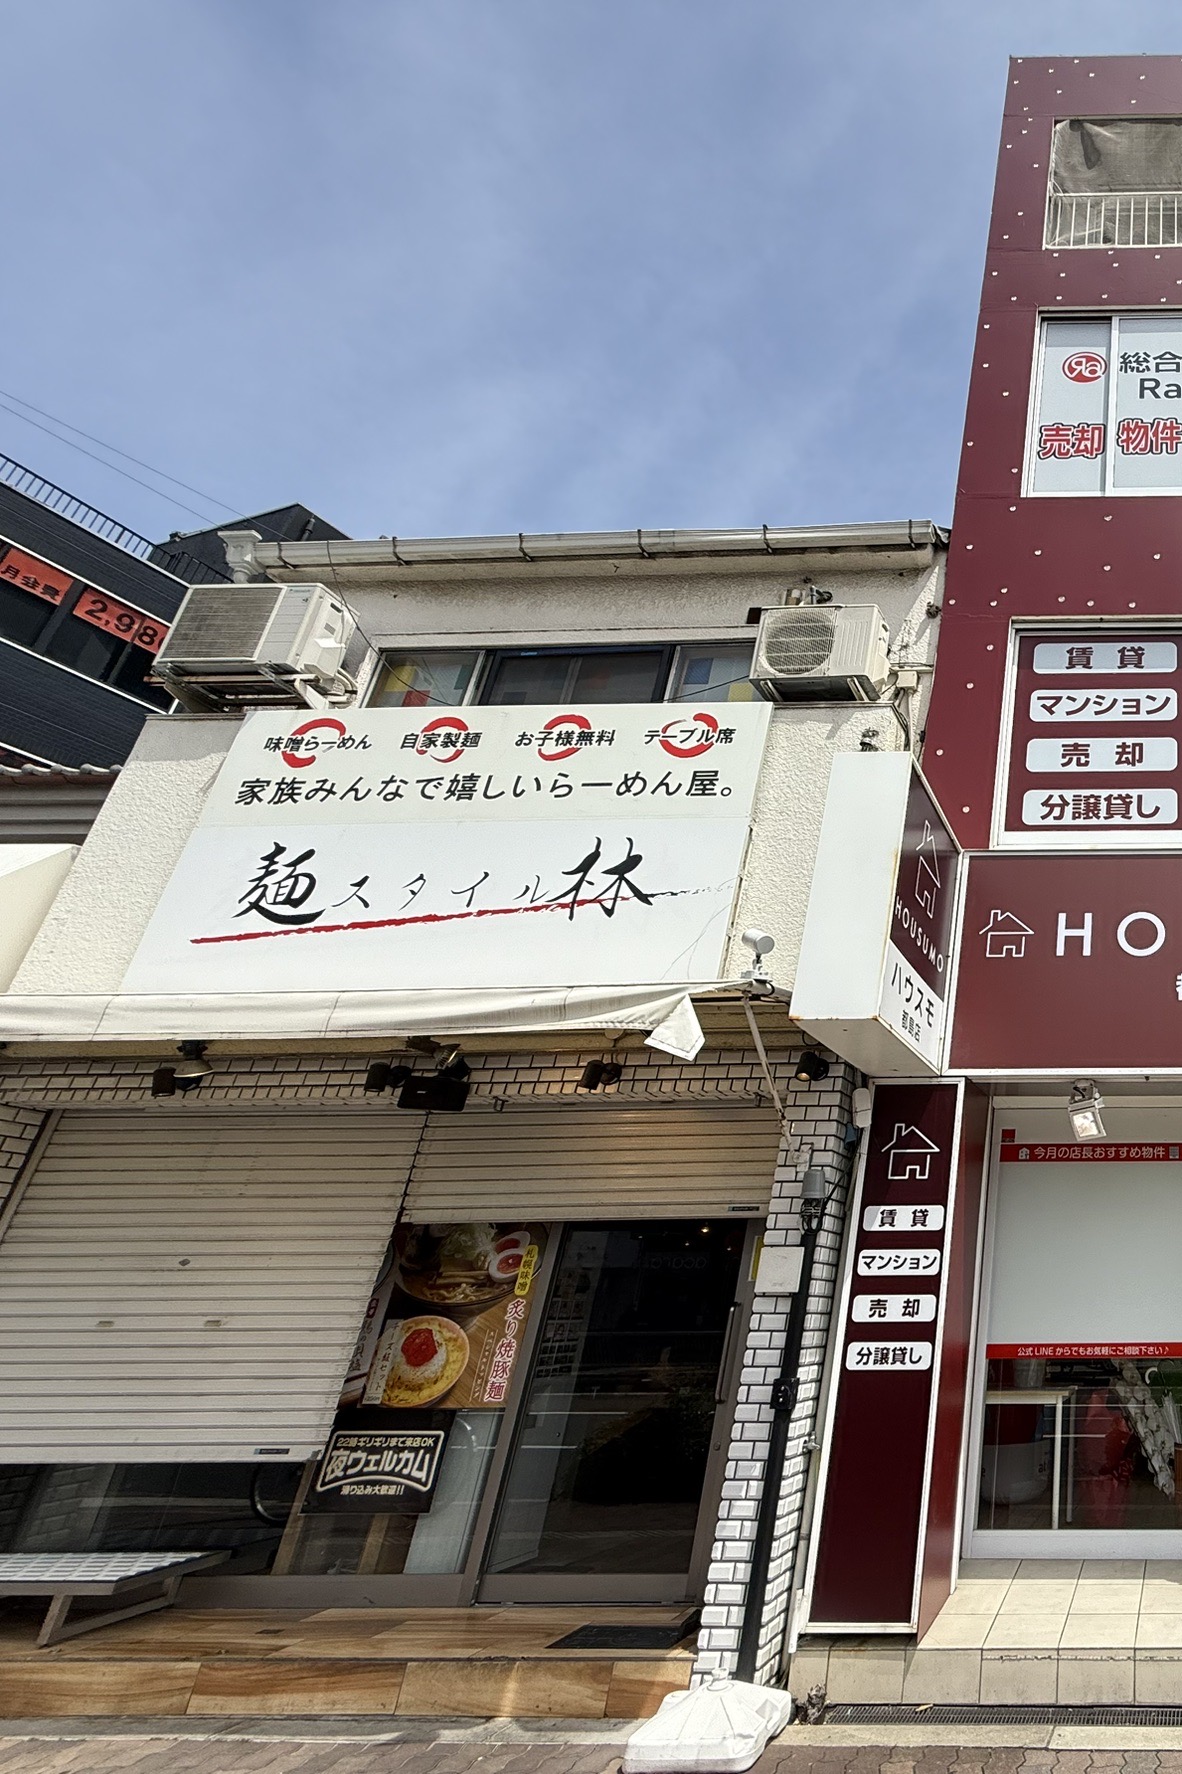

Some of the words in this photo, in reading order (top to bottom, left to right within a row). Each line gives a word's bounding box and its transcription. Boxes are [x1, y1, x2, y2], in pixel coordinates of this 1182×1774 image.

[85, 598, 165, 650] 2,98
[1066, 647, 1145, 669] 賃貸
[1036, 696, 1171, 716] マンション
[263, 734, 372, 753] 味噌らーめん
[400, 731, 483, 750] 自家製麺
[514, 729, 616, 747] お子様無料
[644, 727, 737, 745] テーブル席
[1061, 742, 1144, 767] 売却
[234, 769, 733, 805] 家族みんなで嬉しいらーめん屋。
[1040, 794, 1161, 821] 分譲貸し
[895, 896, 944, 974] HOUSUMO
[892, 962, 935, 1028] ハウスモ
[1034, 1146, 1166, 1159] 今月の店長おすすめ物件
[878, 1209, 930, 1227] 賃貸
[861, 1254, 937, 1271] マンション
[868, 1299, 921, 1318] 売却
[484, 1298, 526, 1402] 炙り焼豚麺
[856, 1347, 923, 1366] 分譲貸し
[325, 1448, 431, 1482] 夜ウェルカム
